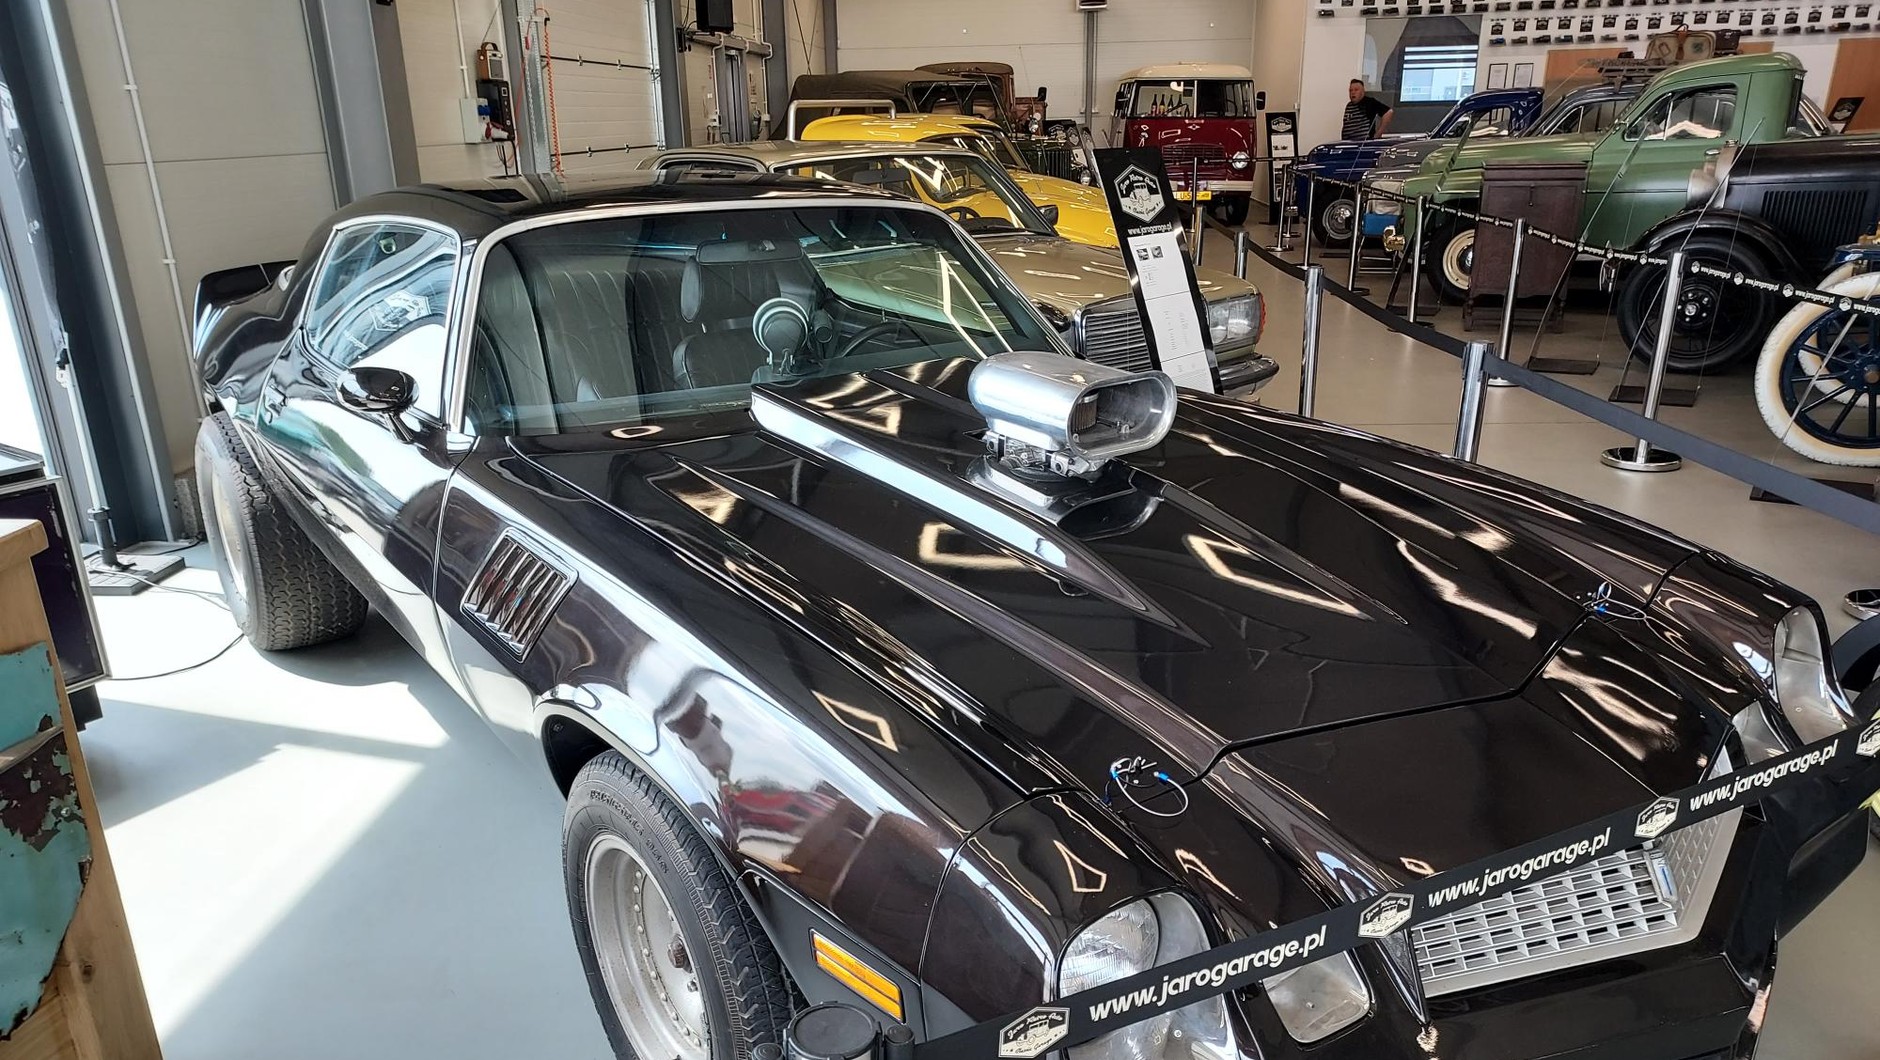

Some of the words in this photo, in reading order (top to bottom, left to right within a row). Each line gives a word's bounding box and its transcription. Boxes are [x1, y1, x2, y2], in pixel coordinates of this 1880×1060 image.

[1127, 221, 1172, 236] www.jarogarage.pl
[1690, 739, 1839, 811] www.jarogarage.pl
[1428, 827, 1611, 908] www.jarogarage.pl
[1089, 924, 1327, 1022] www.jarogarage.pl
